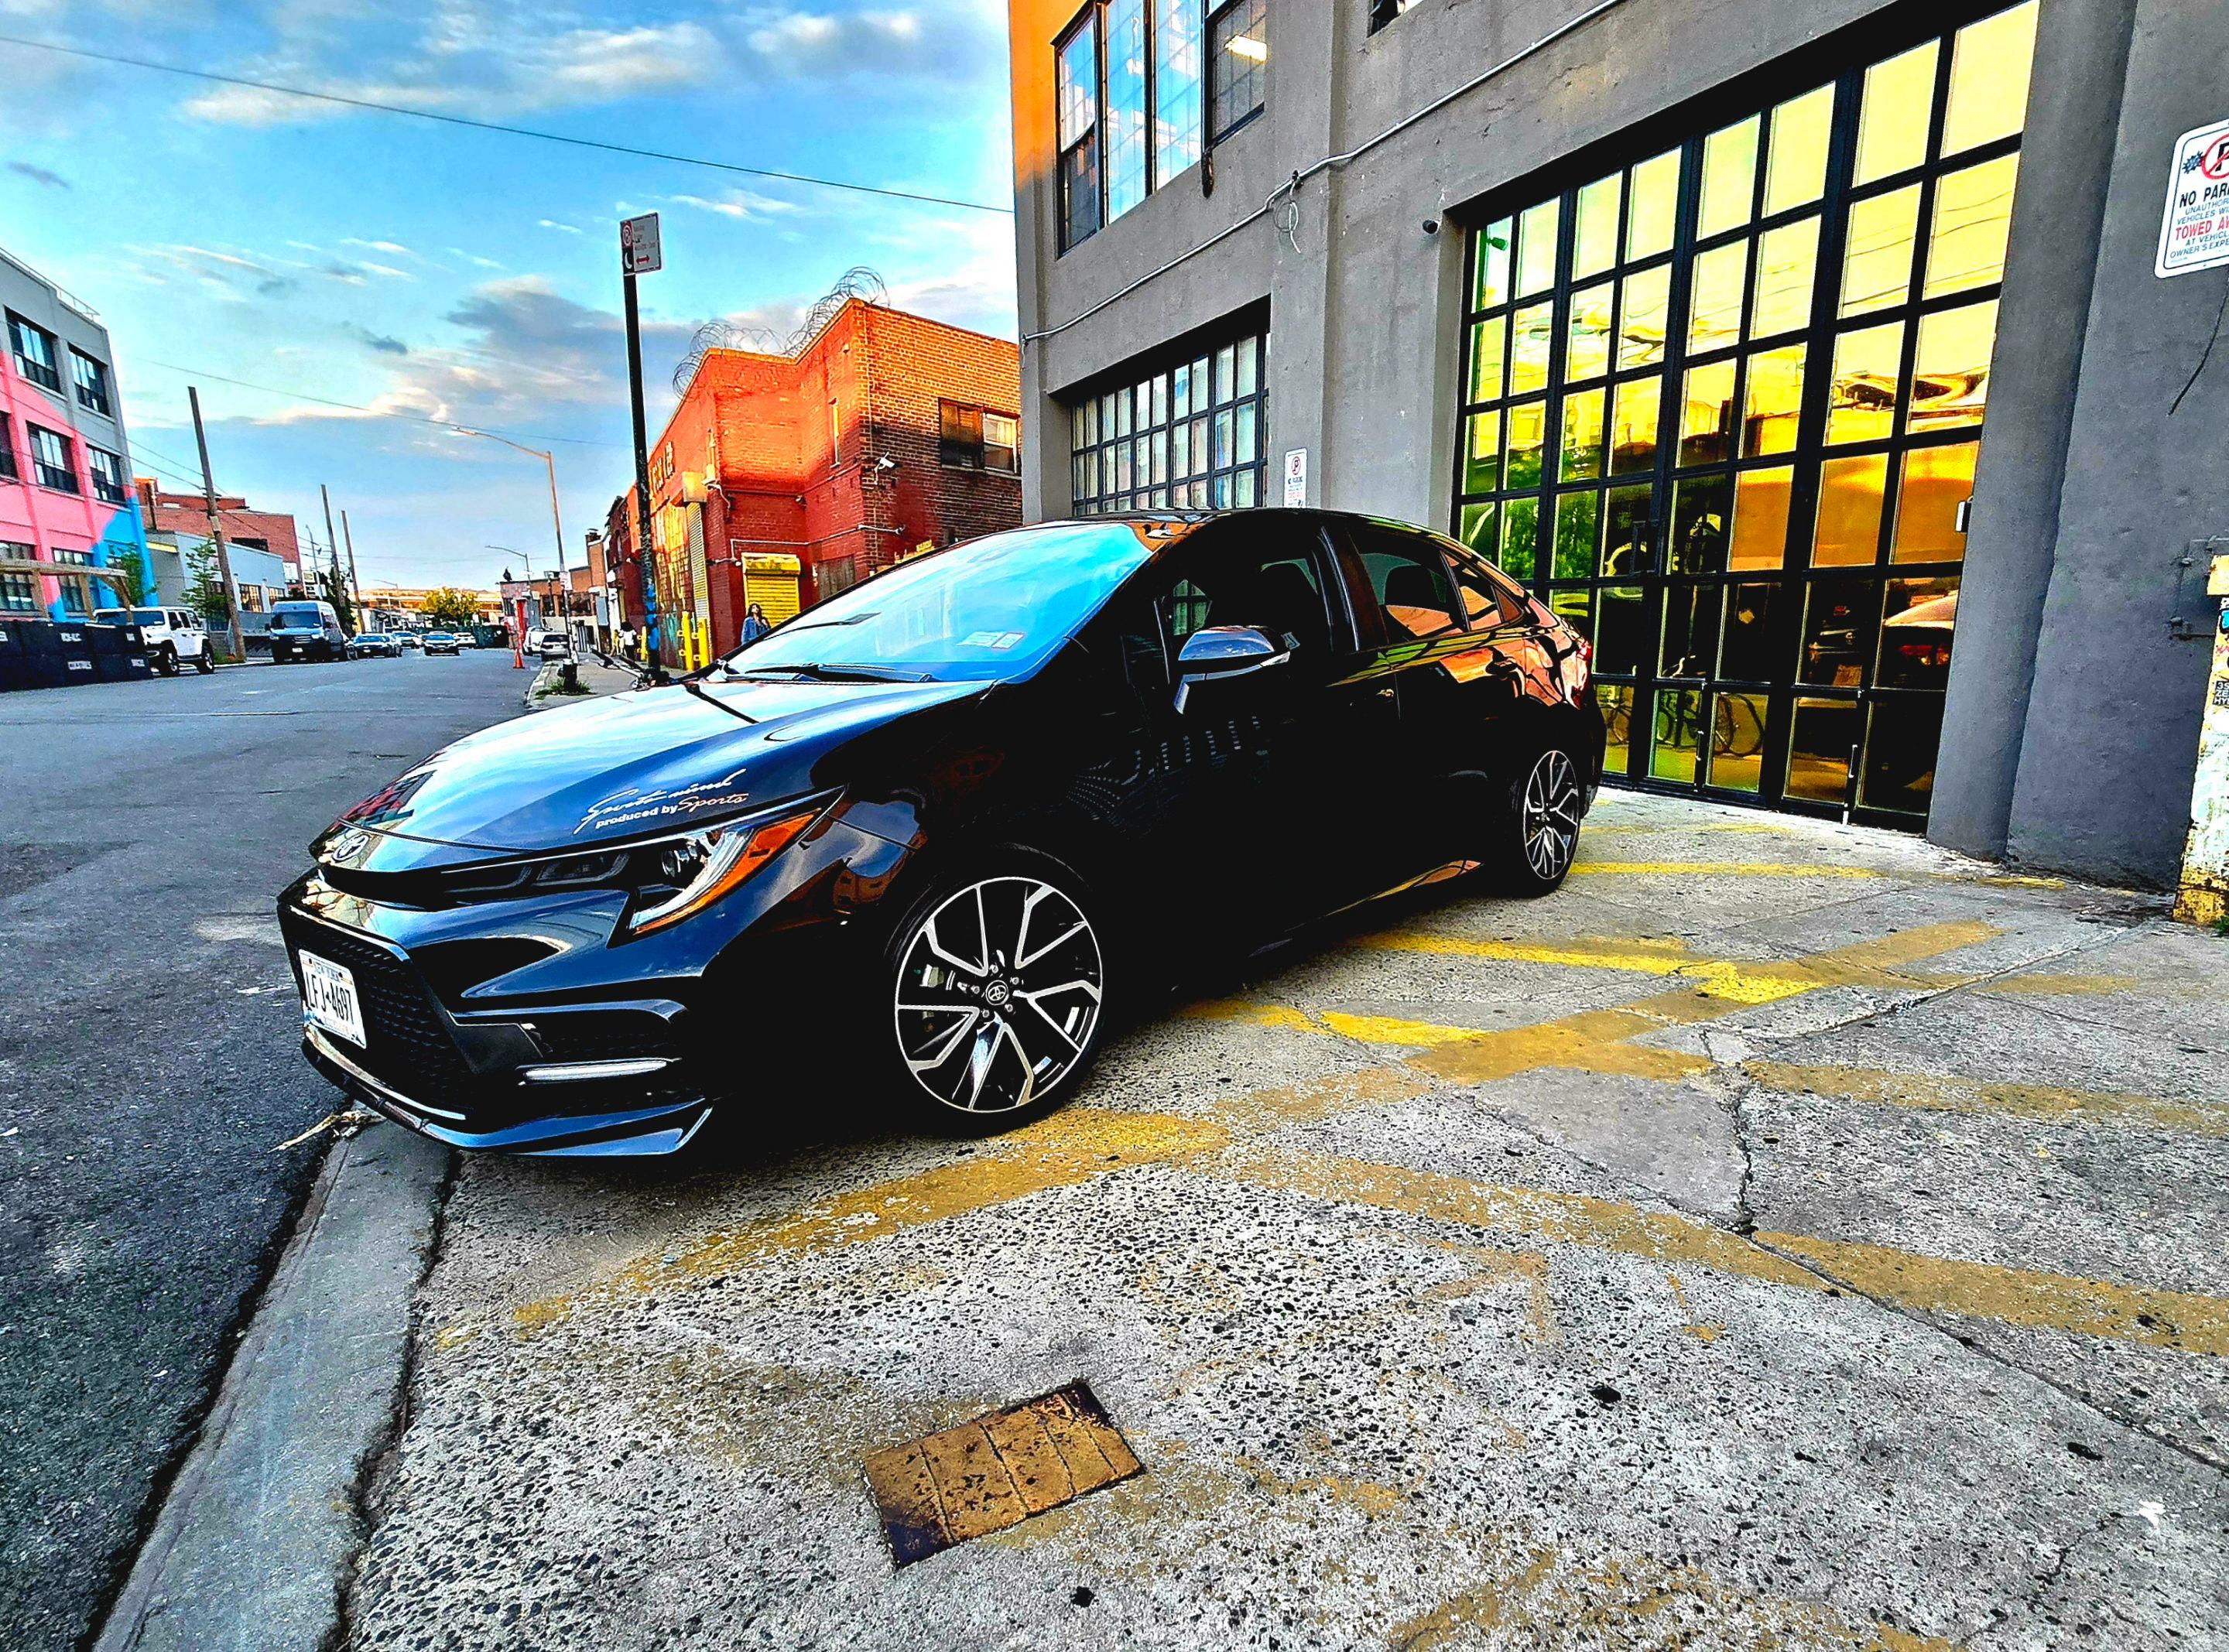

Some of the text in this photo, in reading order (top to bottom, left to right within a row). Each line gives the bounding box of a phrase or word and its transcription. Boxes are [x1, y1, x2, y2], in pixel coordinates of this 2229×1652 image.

[2179, 182, 2229, 208] NO PAR
[2177, 209, 2215, 225] VEHICLES
[2176, 220, 2212, 241] TOWED
[2186, 230, 2229, 246] AT VEHICL
[595, 793, 748, 829] produced by Sports
